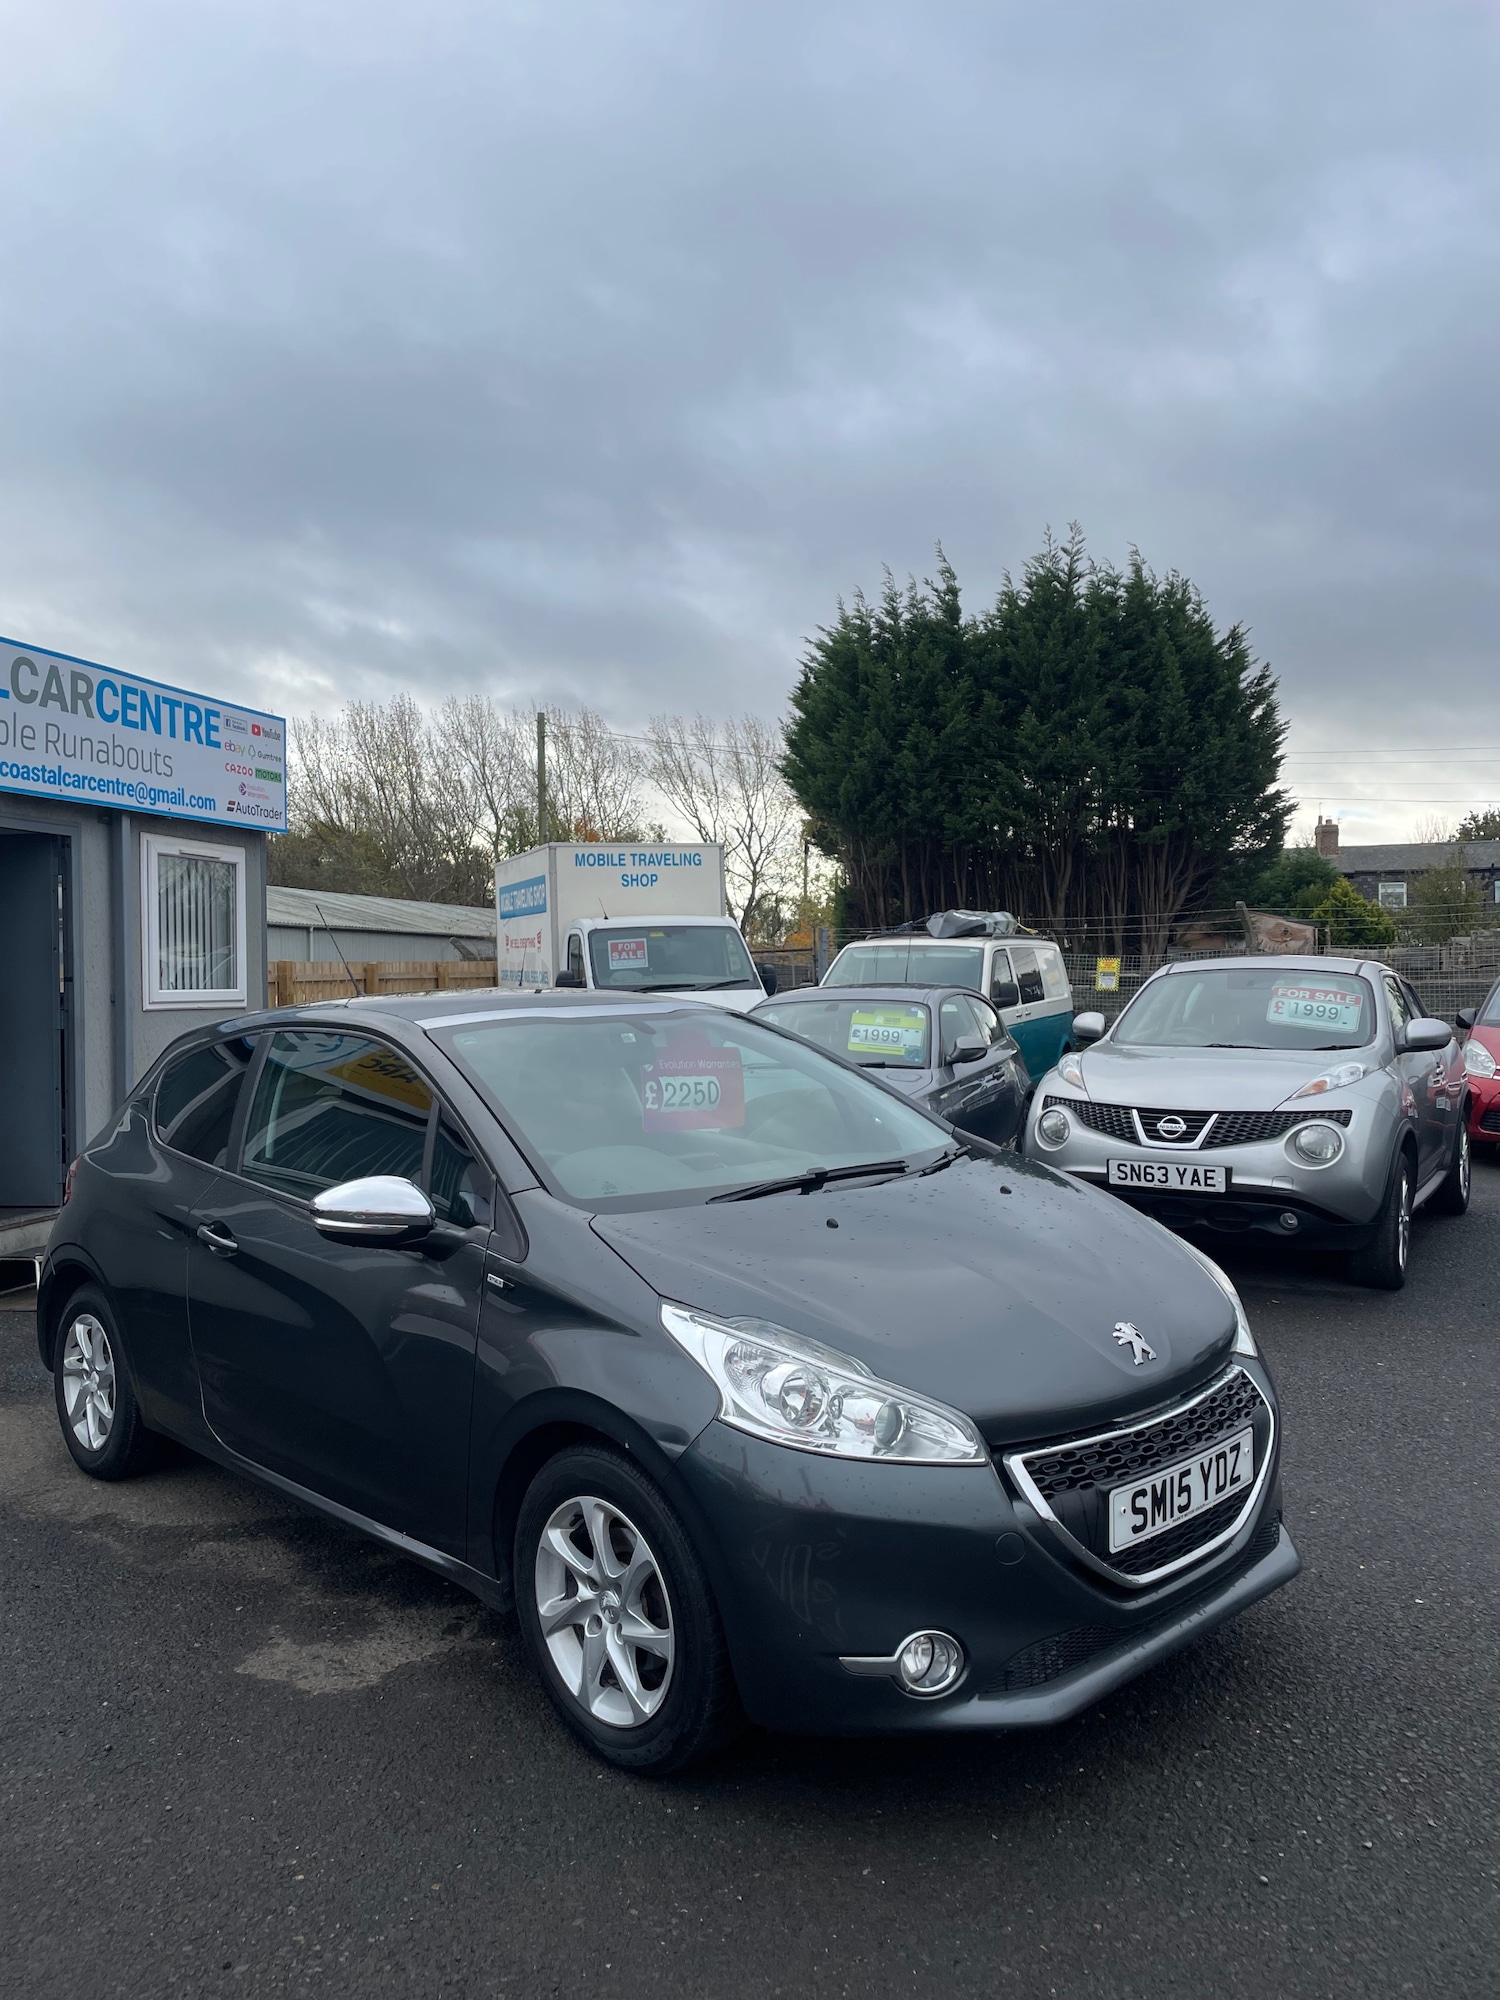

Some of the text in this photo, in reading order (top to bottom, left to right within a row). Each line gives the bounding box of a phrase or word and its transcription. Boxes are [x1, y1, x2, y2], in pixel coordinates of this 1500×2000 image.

[0, 656, 222, 749] CARCENTRE
[44, 722, 174, 778] Runabouts
[224, 739, 245, 757] ebay
[257, 751, 282, 763] Gumtree
[235, 801, 283, 820] AutoTrader
[575, 852, 702, 867] MOBILE TRAVELING
[621, 873, 659, 888] SHOP
[612, 950, 645, 960] SALE
[618, 943, 636, 951] FOR
[1277, 988, 1357, 1004] FOR SALE
[660, 1060, 696, 1069] Evolution
[1117, 1163, 1216, 1188] SN63 YAE
[1131, 1441, 1241, 1535] SM15 YDZ
